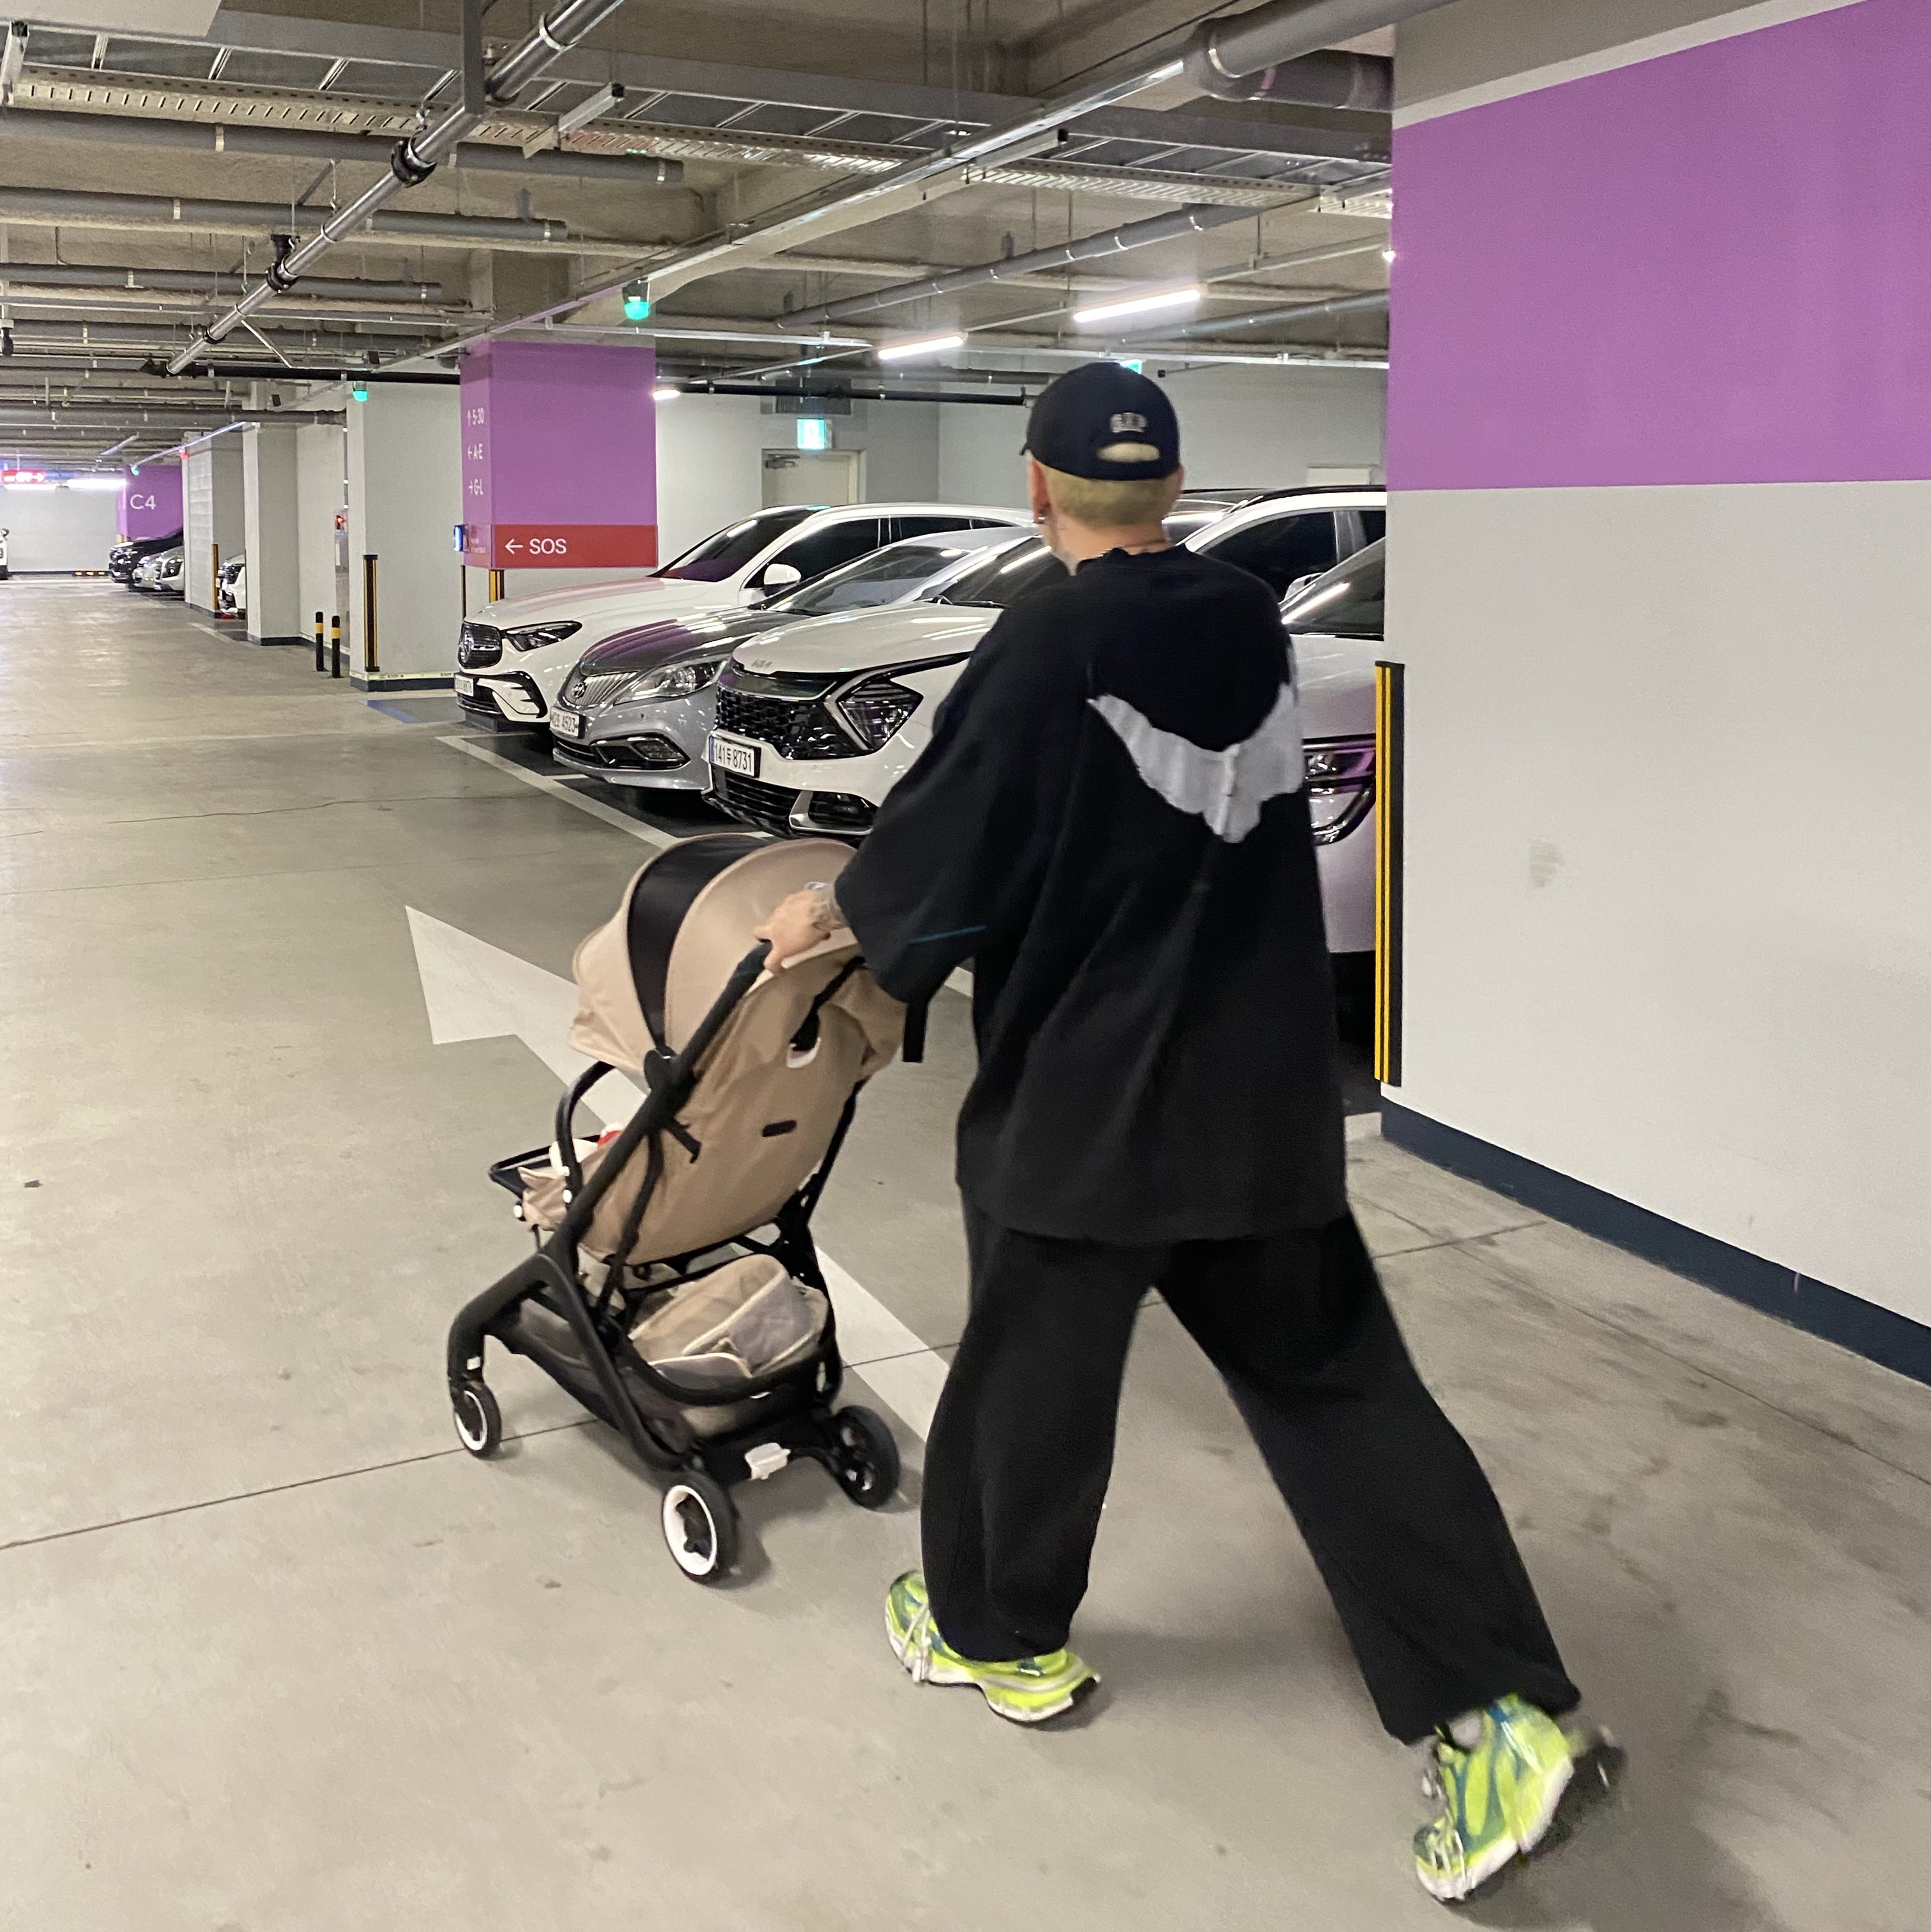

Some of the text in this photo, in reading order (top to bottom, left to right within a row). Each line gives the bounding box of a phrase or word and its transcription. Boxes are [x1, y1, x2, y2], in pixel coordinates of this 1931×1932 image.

[130, 494, 156, 510] C4
[529, 538, 567, 555] SOS
[733, 748, 752, 772] 8731
